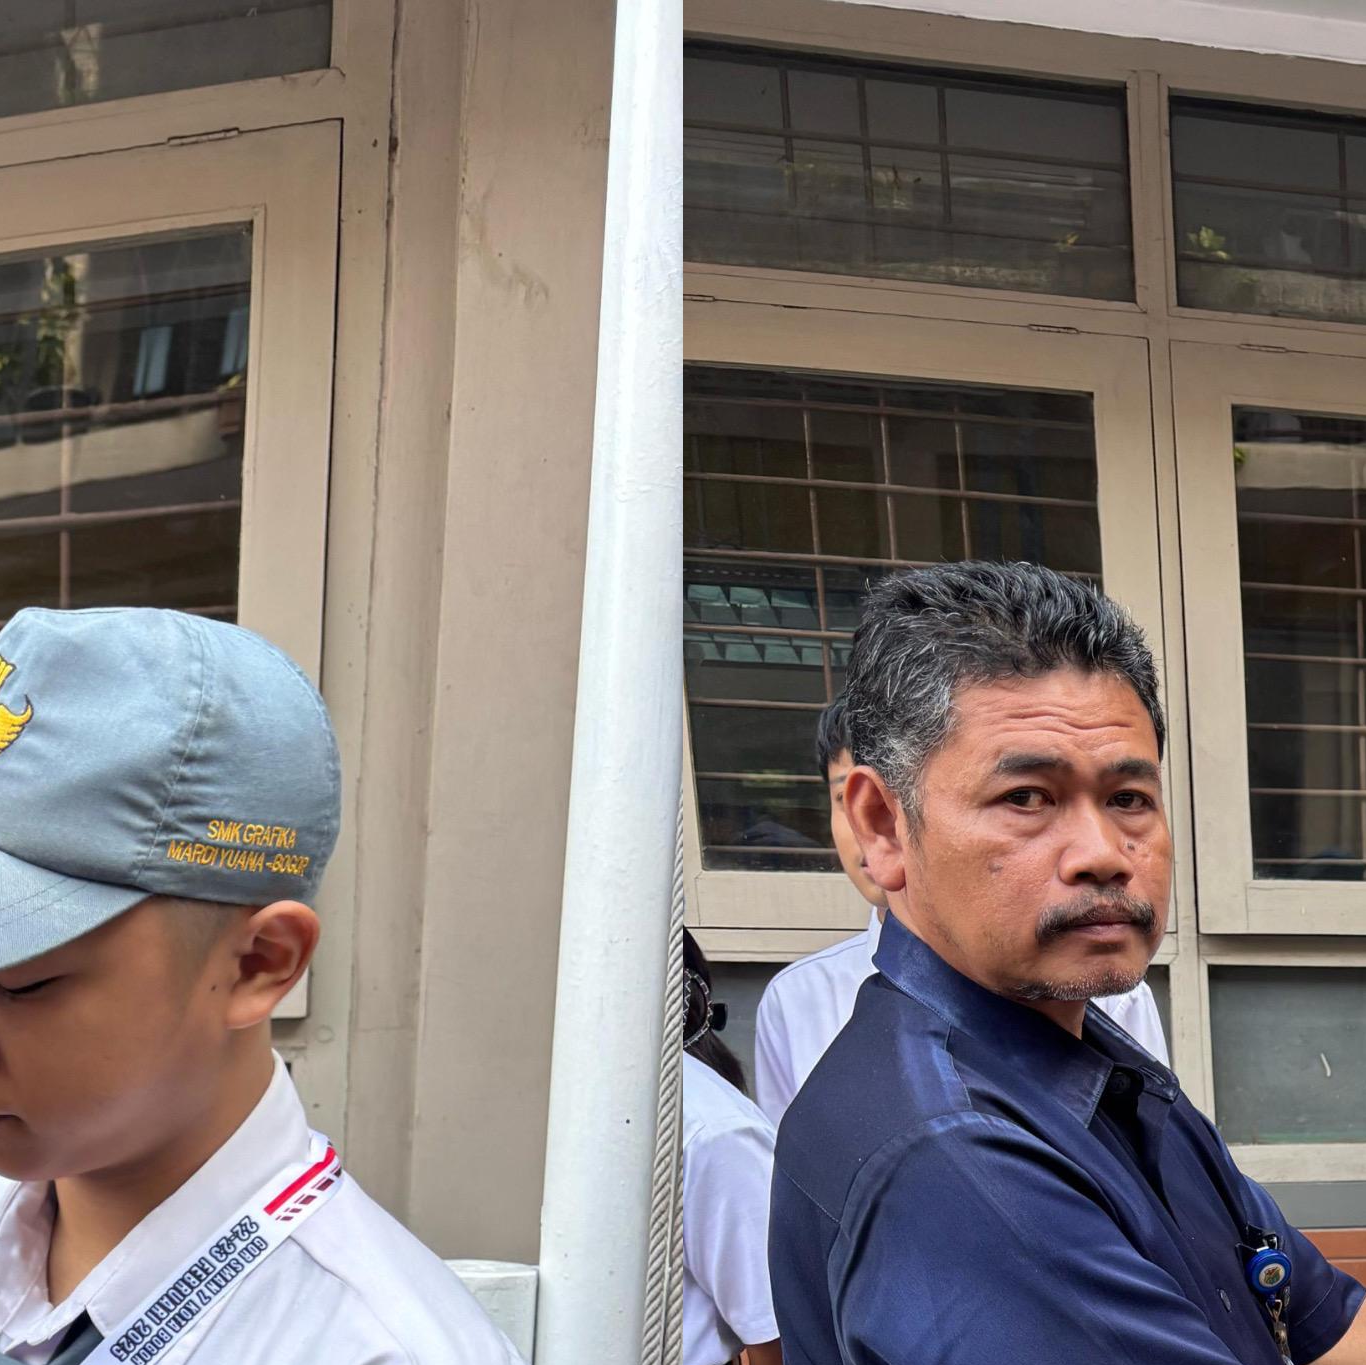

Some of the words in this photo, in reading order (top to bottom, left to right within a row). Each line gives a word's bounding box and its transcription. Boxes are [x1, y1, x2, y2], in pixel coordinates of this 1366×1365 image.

[206, 819, 244, 843] SMK
[243, 823, 297, 849] GRAFIKA
[166, 840, 219, 867] MARDI
[218, 848, 266, 873] YUANA
[208, 1214, 260, 1263] 22-23
[237, 1235, 269, 1264] GOR
[143, 1256, 217, 1327] FEBRUARI
[203, 1257, 246, 1296] SMAN
[195, 1288, 212, 1306] 7
[165, 1298, 202, 1334] KOTA
[109, 1317, 153, 1363] 2025
